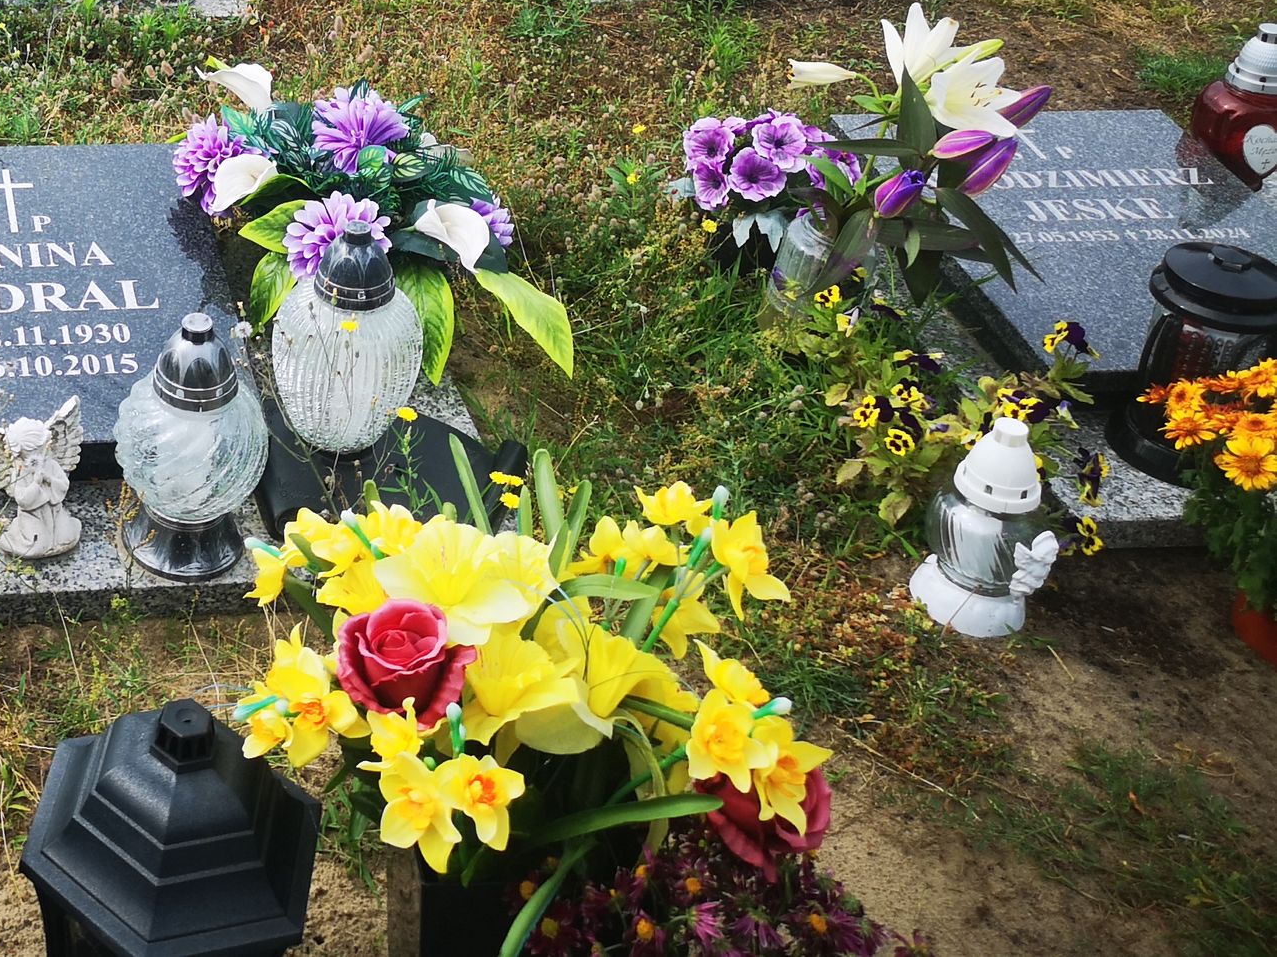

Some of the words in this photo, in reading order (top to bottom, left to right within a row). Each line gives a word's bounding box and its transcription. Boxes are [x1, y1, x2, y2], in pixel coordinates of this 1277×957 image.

[1023, 198, 1175, 223] JESKE
[32, 215, 51, 232] P
[1143, 228, 1251, 243] 28.11.2024
